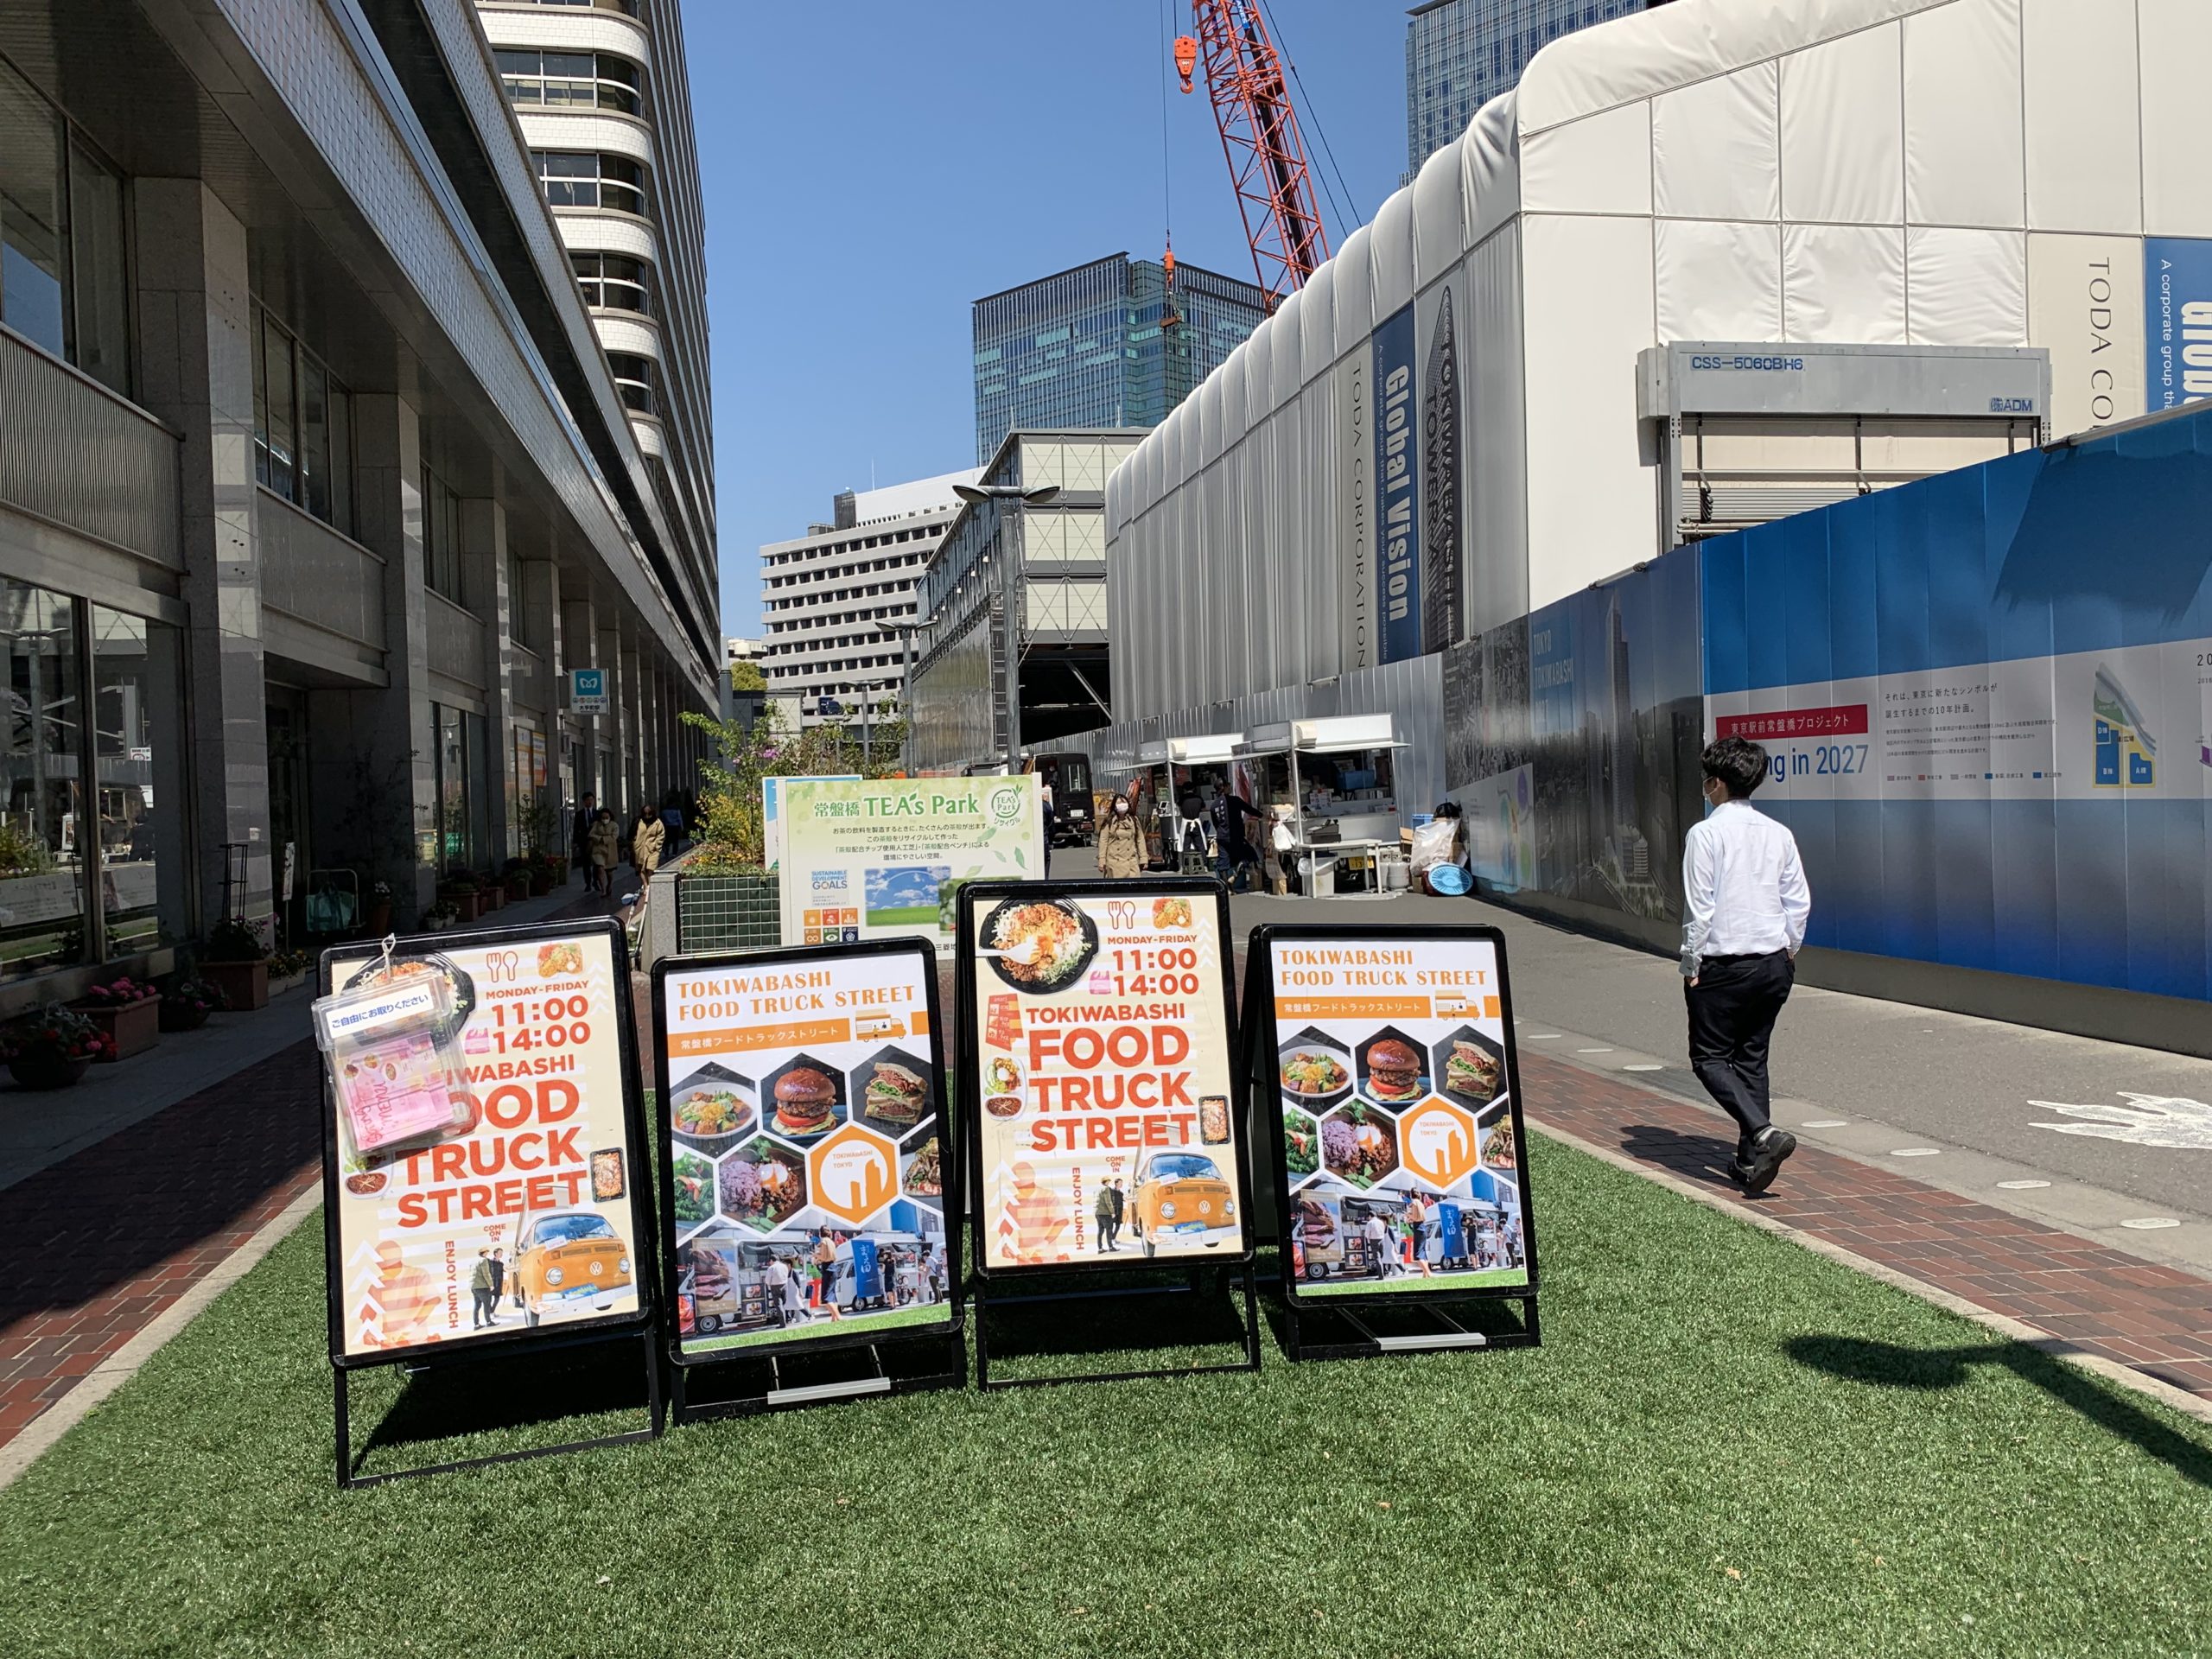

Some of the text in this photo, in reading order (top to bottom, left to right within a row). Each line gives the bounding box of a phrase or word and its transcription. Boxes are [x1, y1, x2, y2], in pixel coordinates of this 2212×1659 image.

[2161, 258, 2172, 270] A
[2160, 274, 2172, 341] corporate
[2089, 257, 2113, 430] TODA CO
[2161, 346, 2172, 386] group
[1427, 386, 1439, 569] TOWER-A
[1441, 335, 1455, 605] TOKIWABASHI
[1386, 365, 1411, 621] Global Vision
[1353, 361, 1366, 668] TODA CORPORATION
[1534, 629, 1552, 656] TOKYO
[1535, 657, 1574, 690] TOKIWABASHI
[1885, 683, 1998, 702] それは、東京に新たなシンボルが
[1731, 714, 1849, 734] 東京駅前常盤橋プロジェクト
[1885, 703, 1974, 719] 誕生するまでの10年計画。
[1792, 747, 1809, 775] in
[1816, 744, 1869, 775] 2027
[813, 802, 861, 817] 常盤橋
[931, 793, 979, 815] Park
[994, 817, 1020, 826] リサイクル
[812, 880, 848, 890] GOALS
[1108, 935, 1198, 944] MONDAY-FRIDAY
[1112, 948, 1198, 971] 11:00
[1279, 950, 1413, 965] TOKIWABASHI
[486, 980, 589, 1000] MONDAY-FRIDAY
[677, 970, 832, 999] TOKIWABASHI
[1114, 973, 1199, 996] 14:00
[1281, 969, 1486, 986] FOOD TRUCK STREET
[331, 995, 429, 1028] ご自由にお取りください
[492, 995, 589, 1027] 11:00
[679, 985, 916, 1021] FOOD TRUCK STREET
[1026, 1003, 1185, 1024] TOKIWABASHI
[1284, 1002, 1421, 1013] 常盤橋フードトラックストリート
[493, 1021, 591, 1054] 14:00
[680, 1026, 839, 1051] 常盤橋フードトラックストリート
[1028, 1025, 1190, 1071] FOOD
[1028, 1071, 1194, 1112] TRUCK
[1031, 1113, 1197, 1152] STREET
[395, 1126, 588, 1186] TRUCK
[397, 1170, 588, 1228] STREET
[1072, 1167, 1084, 1250] ENJOY LUNCH
[483, 1224, 506, 1233] COME
[445, 1241, 459, 1329] ENJOY LUNCH
